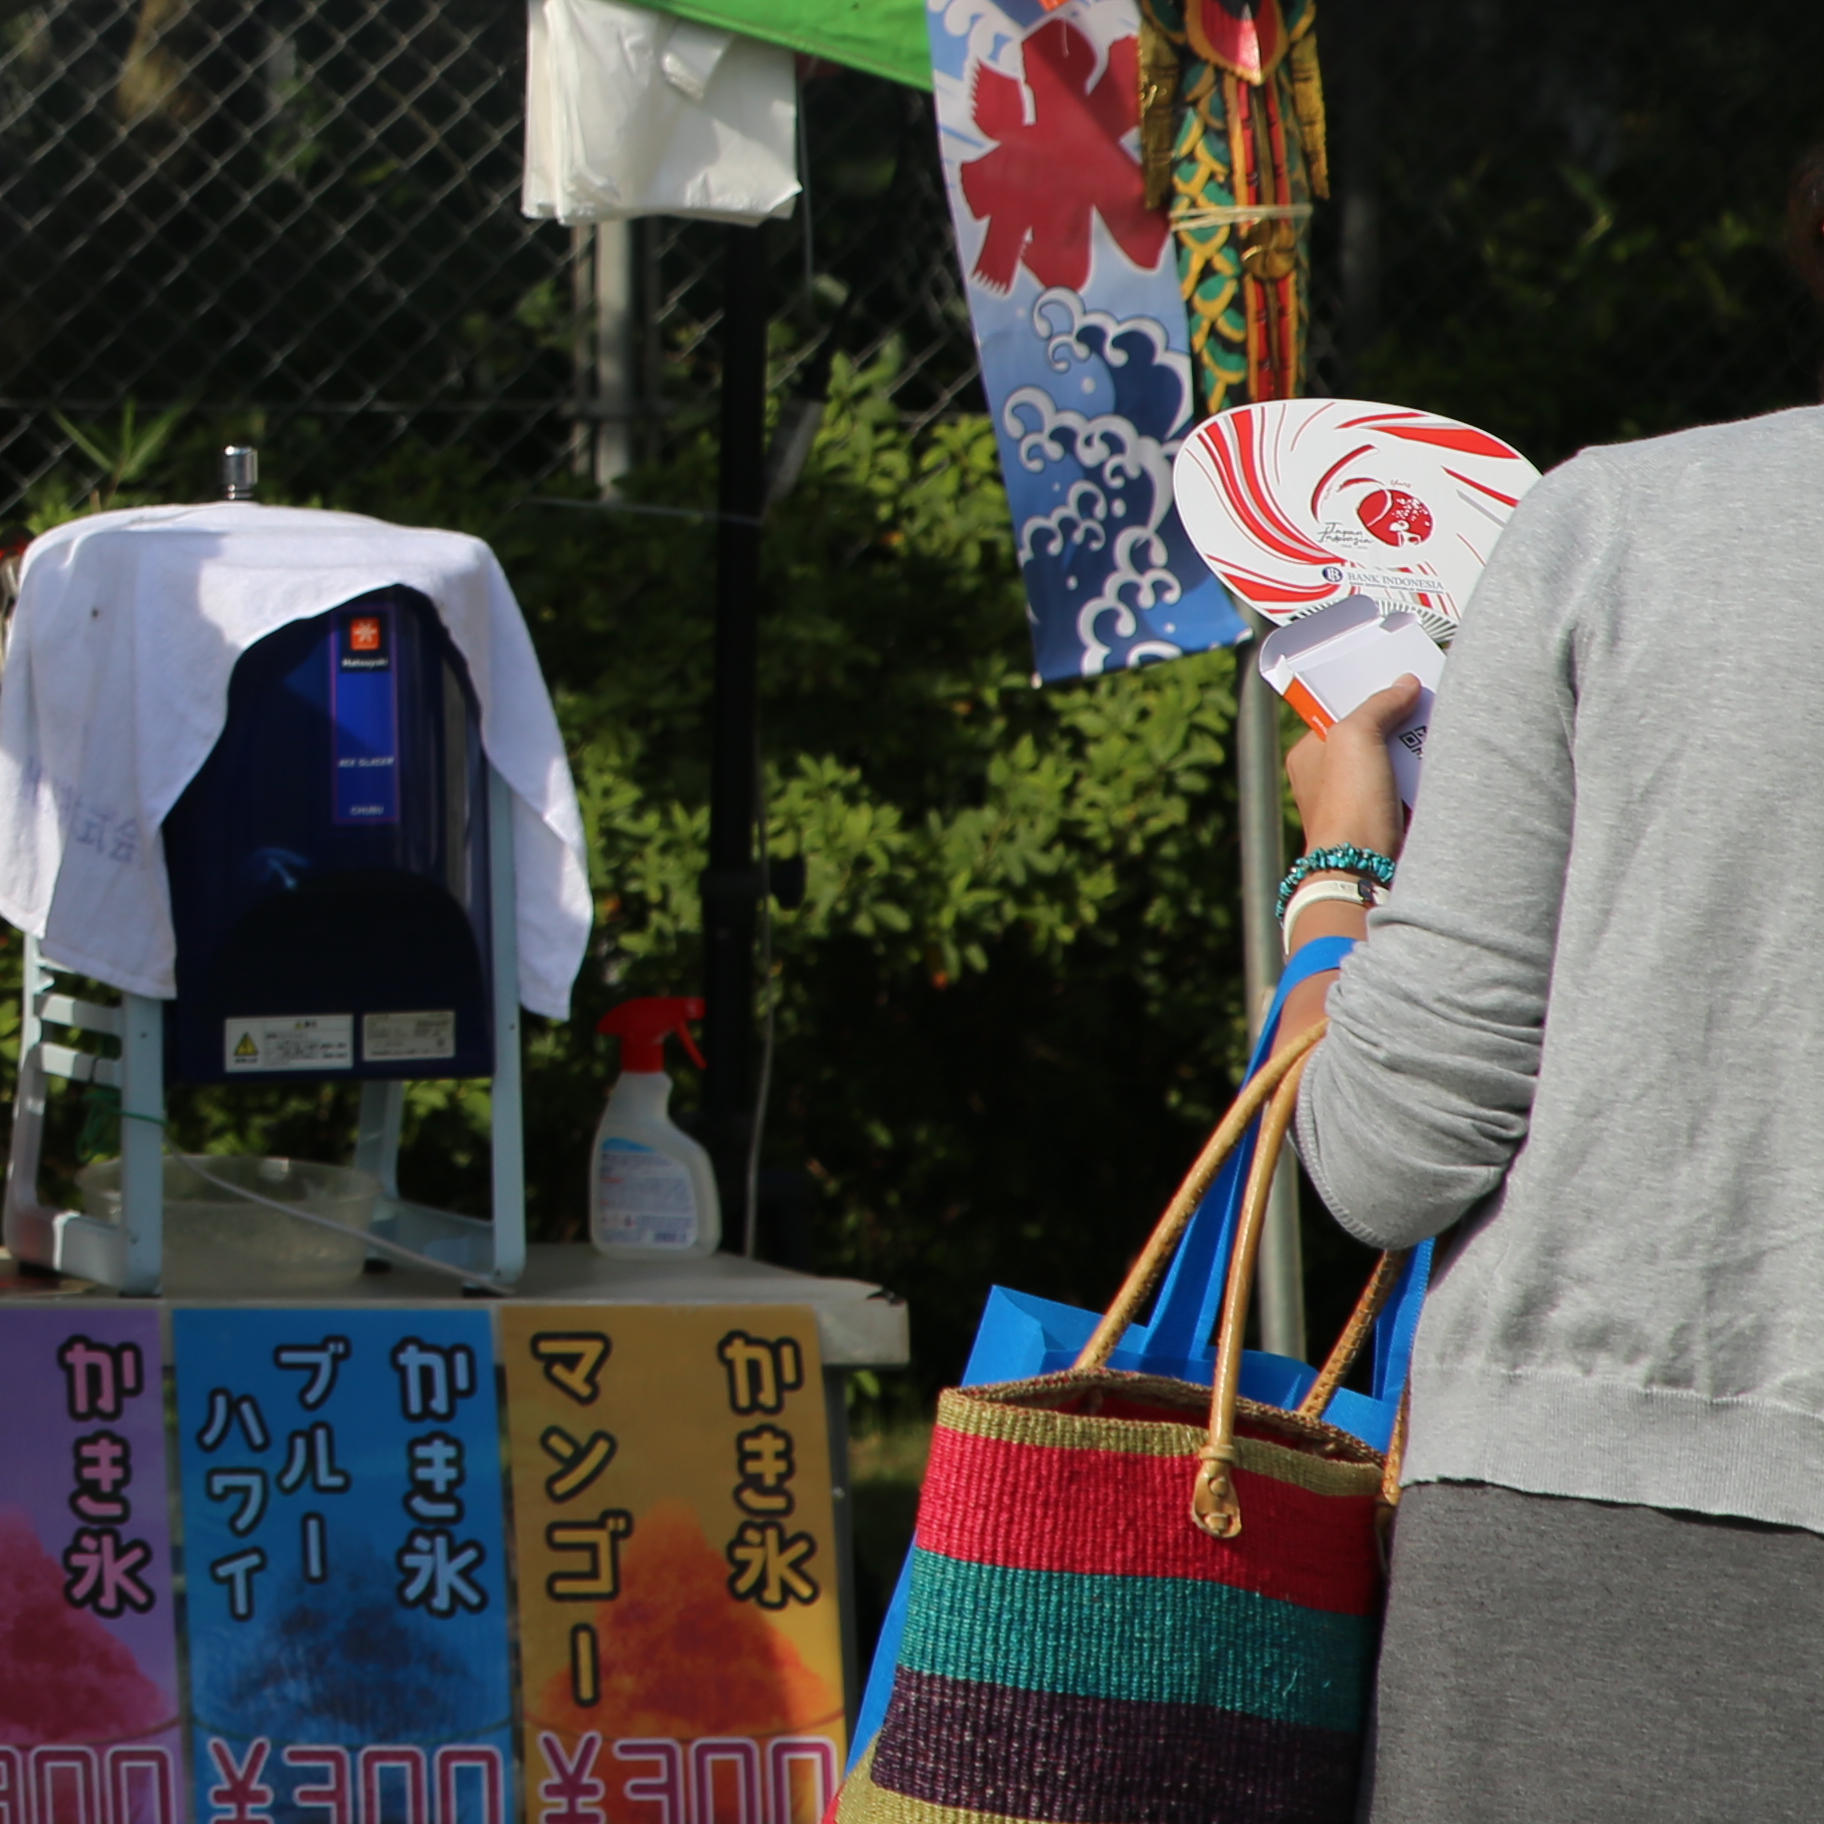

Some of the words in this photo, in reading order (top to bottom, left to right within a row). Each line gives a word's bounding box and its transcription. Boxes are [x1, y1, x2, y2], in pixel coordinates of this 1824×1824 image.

[1348, 572, 1380, 584] BANK
[1382, 575, 1444, 590] INDONESIA
[58, 1335, 154, 1617] かき氷
[198, 1389, 270, 1624] ハワイ
[277, 1336, 350, 1584] ブルー
[393, 1334, 488, 1617] かき氷
[533, 1330, 633, 1708] マンゴー
[718, 1329, 820, 1611] かき氷
